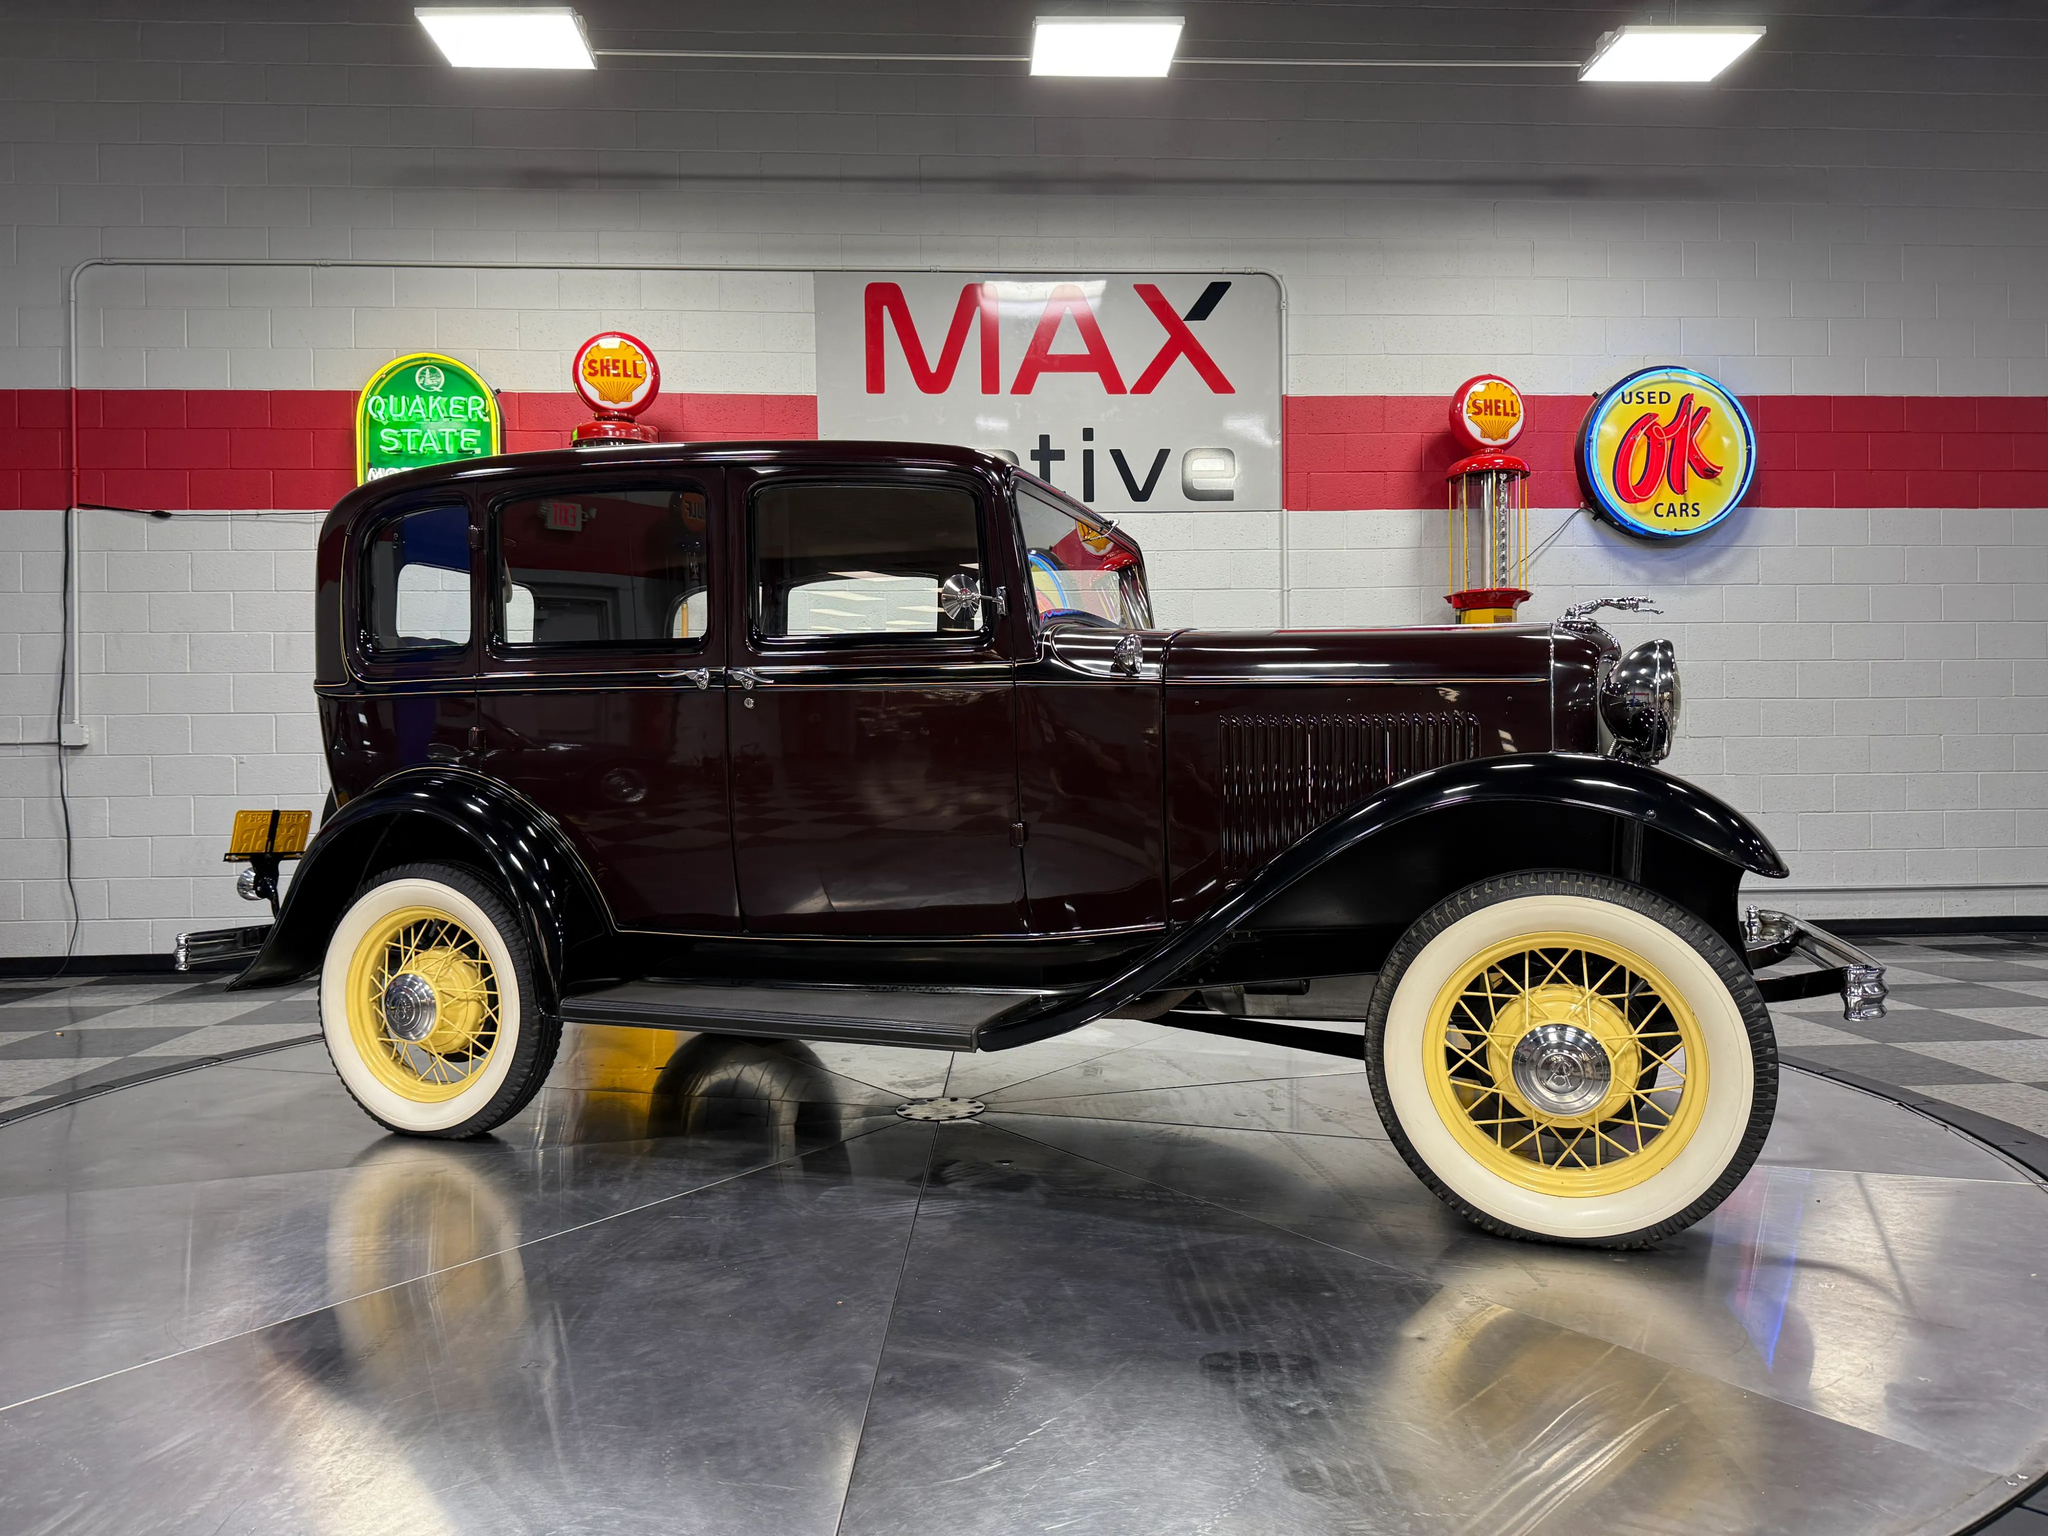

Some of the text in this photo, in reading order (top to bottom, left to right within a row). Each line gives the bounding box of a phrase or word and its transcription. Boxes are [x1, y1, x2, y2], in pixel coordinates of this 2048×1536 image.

[864, 281, 1236, 395] MAX
[587, 358, 645, 378] SHELL
[1472, 398, 1518, 417] SHELL
[1621, 391, 1671, 405] USED
[367, 395, 489, 423] QUAKER
[379, 428, 481, 453] STATE
[1653, 502, 1701, 518] CARS
